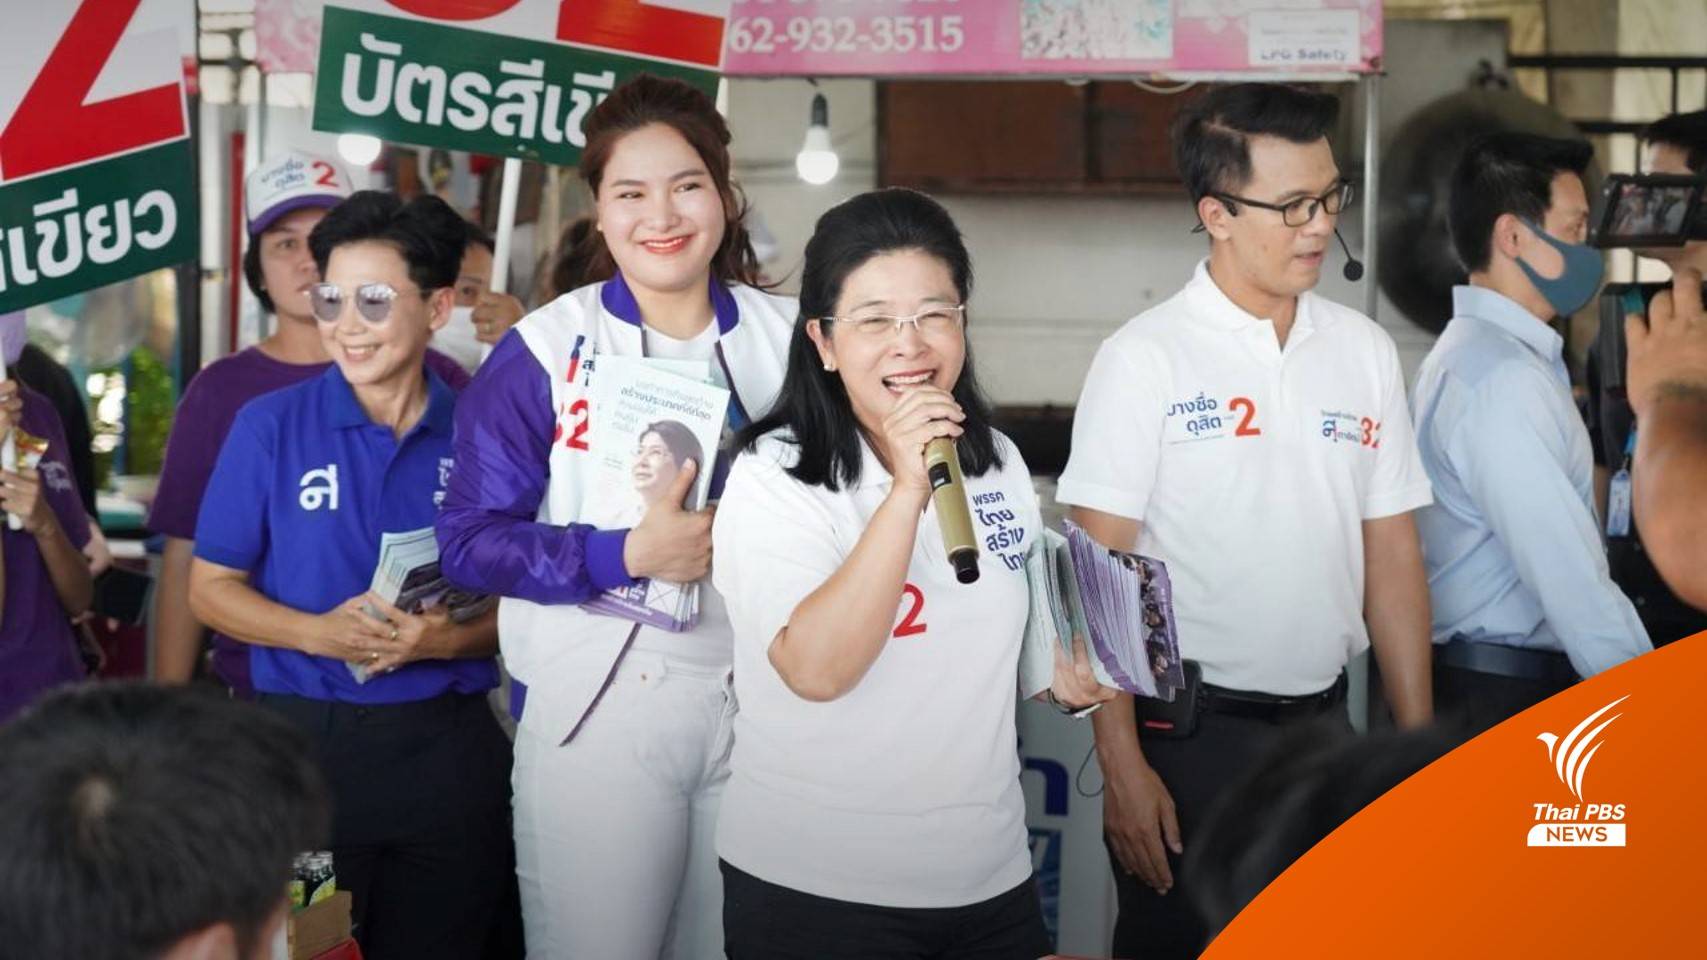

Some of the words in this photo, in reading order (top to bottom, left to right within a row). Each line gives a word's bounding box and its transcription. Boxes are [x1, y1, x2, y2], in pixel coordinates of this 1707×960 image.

[341, 32, 616, 148] บัตรสีเขี
[311, 160, 340, 188] 2
[0, 188, 178, 292] เขียว
[1228, 396, 1262, 438] 2
[972, 491, 1005, 507] พรรค
[975, 508, 1015, 527] ไทย
[986, 523, 1025, 551] สร้าง
[893, 582, 928, 638] 2
